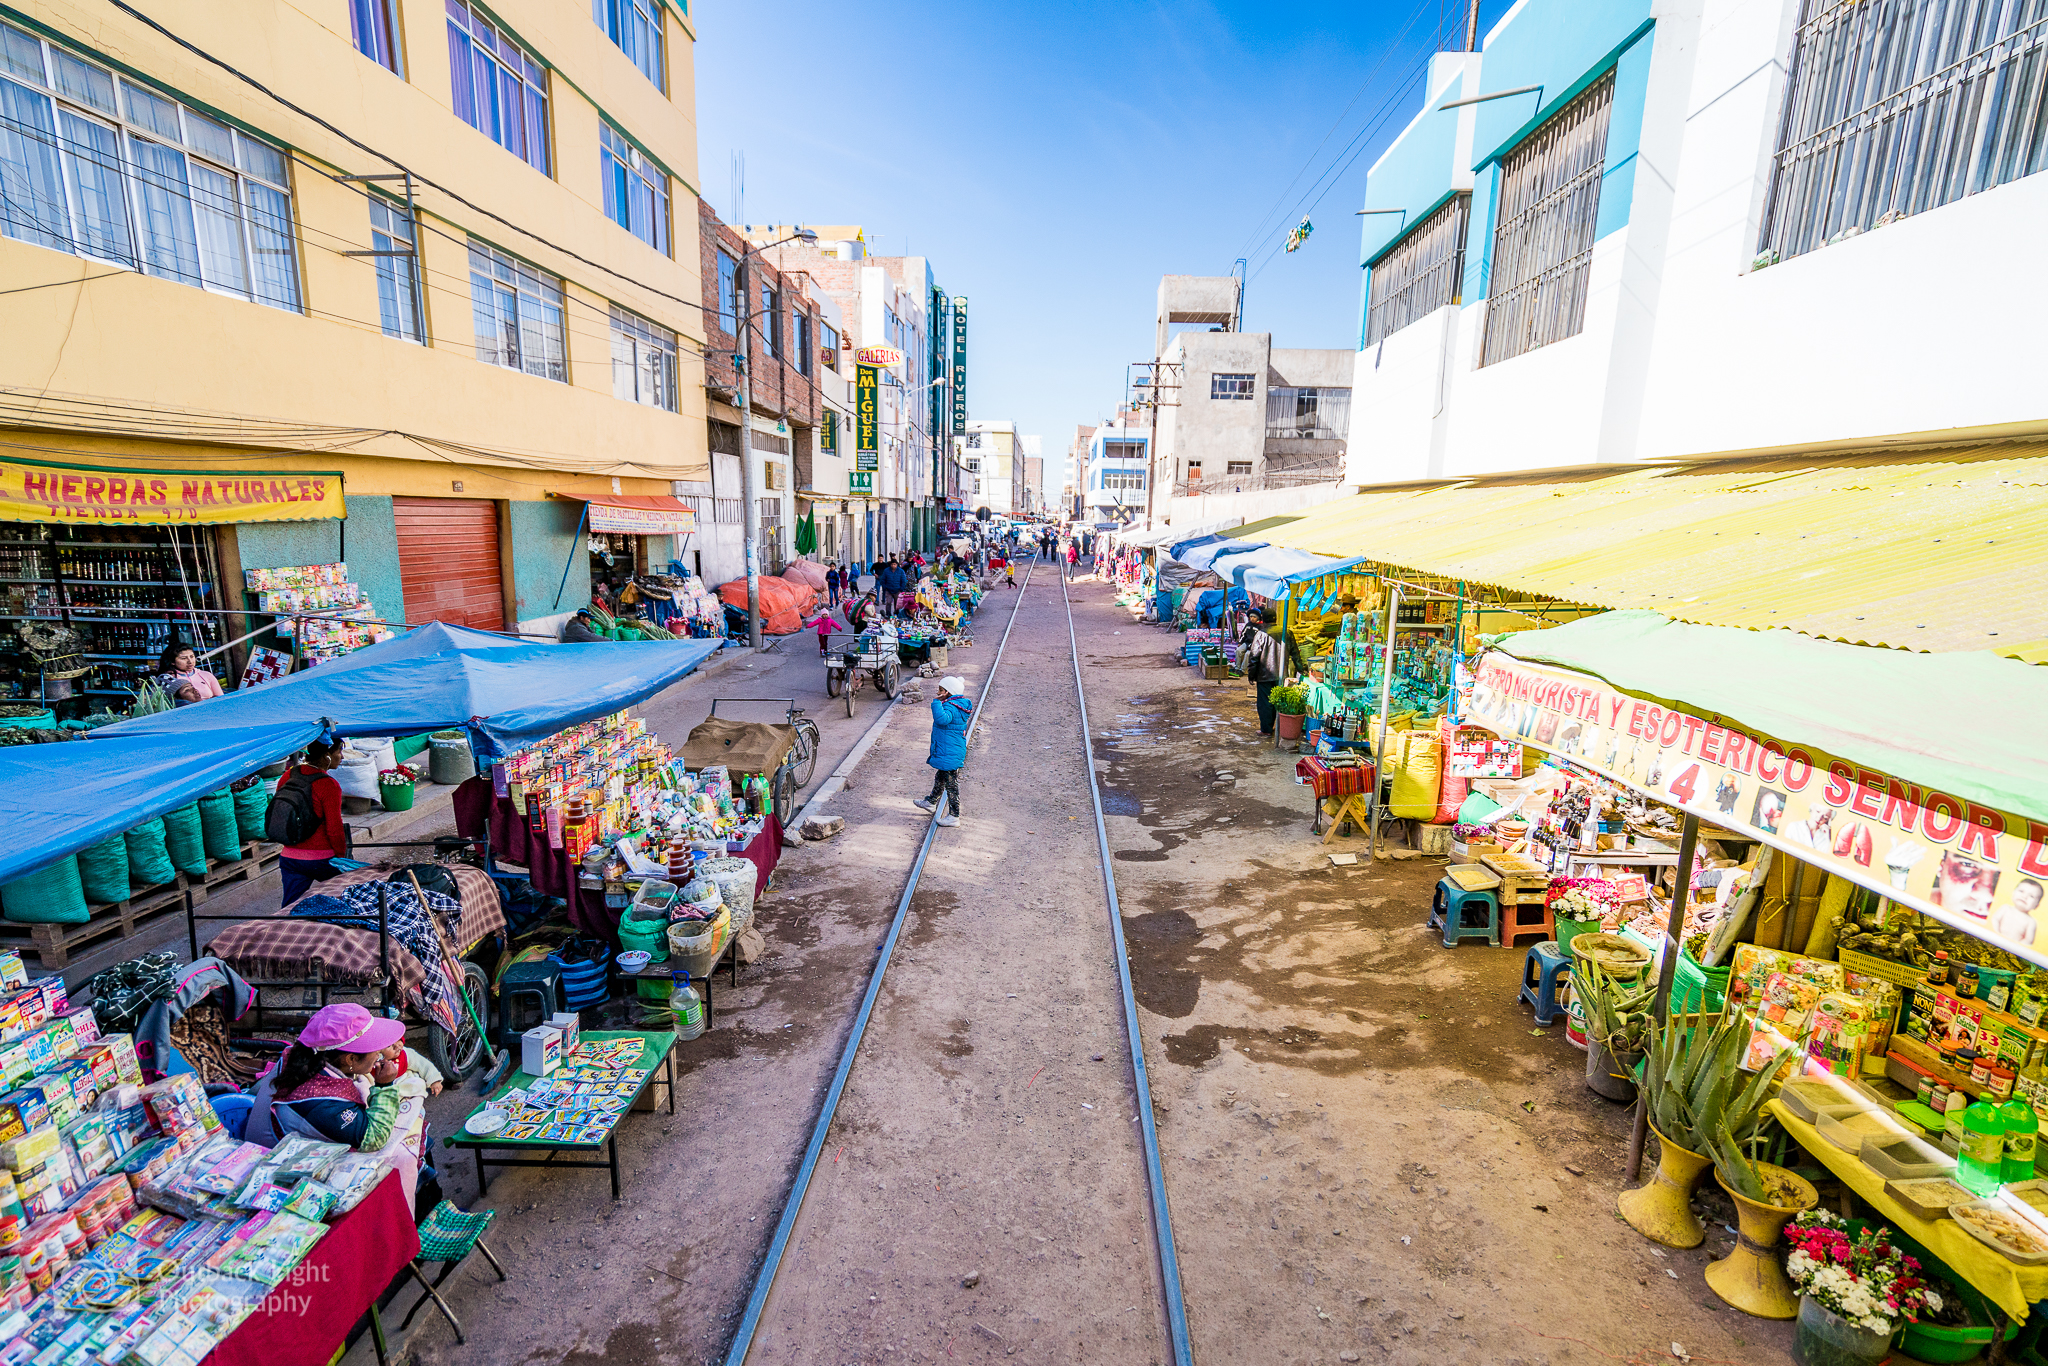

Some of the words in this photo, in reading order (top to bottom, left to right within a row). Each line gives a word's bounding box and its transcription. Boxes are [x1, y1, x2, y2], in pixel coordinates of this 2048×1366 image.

[857, 349, 900, 363] GALERIAS
[954, 365, 966, 429] RIVEROS
[858, 375, 876, 449] MIGUEL
[24, 471, 167, 506] HIERBAS
[181, 479, 325, 506] NATURALES
[48, 504, 139, 519] TIENDA
[1512, 671, 1601, 725] NATURISTA
[1609, 694, 1627, 730] Y
[1627, 702, 1815, 792] ESOTÉRICO
[1822, 759, 2007, 864] SEÑOR
[1669, 763, 1701, 805] 4
[21, 1000, 44, 1017] CUBANO
[1913, 994, 1934, 1012] NONI
[74, 1020, 96, 1036] CHIA
[48, 1083, 69, 1100] SANKY
